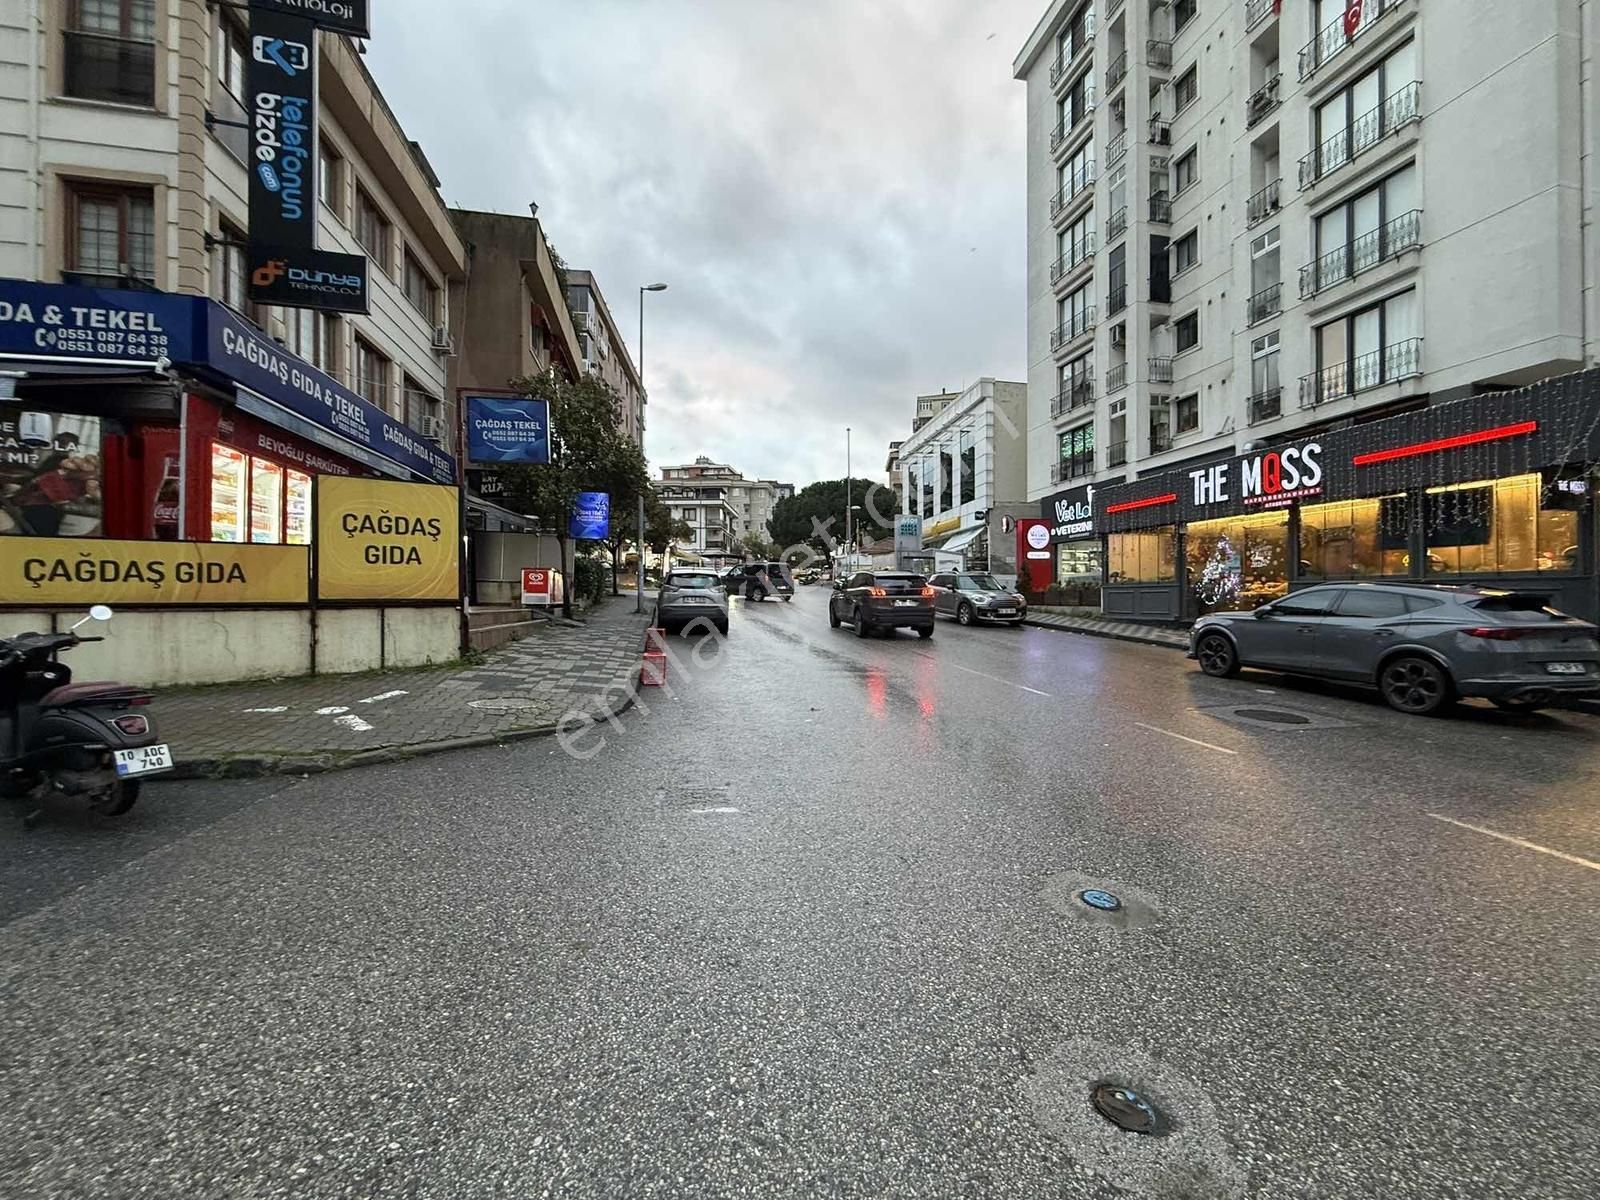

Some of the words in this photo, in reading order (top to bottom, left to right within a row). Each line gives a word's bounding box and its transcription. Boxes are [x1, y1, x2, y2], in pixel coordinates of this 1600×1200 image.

[255, 92, 281, 162] bizde
[281, 95, 307, 220] telefonun
[71, 306, 162, 332] TEKEL
[58, 328, 93, 340] 0551
[98, 331, 124, 343] 087
[127, 334, 146, 345] 64
[150, 335, 168, 346] 38
[58, 342, 93, 353] 0551
[98, 344, 124, 355] 087
[127, 346, 146, 356] 64
[150, 347, 168, 358] 39
[223, 327, 288, 385] ÇAĞDAŞ
[291, 368, 322, 402] GIDA
[334, 394, 365, 425] TEKEL
[475, 419, 512, 430] ÇAĞDAŞ
[514, 421, 541, 430] TEKEL
[258, 434, 304, 464] BEYOĞLU
[383, 423, 413, 455] ÇAĞDAŞ
[1189, 463, 1229, 506] THE
[1055, 499, 1075, 522] Vet
[344, 508, 441, 542] ÇAĞDAŞ
[364, 544, 422, 566] GIDA
[23, 552, 165, 589] ÇAĞDAŞ
[175, 561, 246, 584] GIDA
[120, 751, 134, 761] 10
[140, 757, 163, 768] 740
